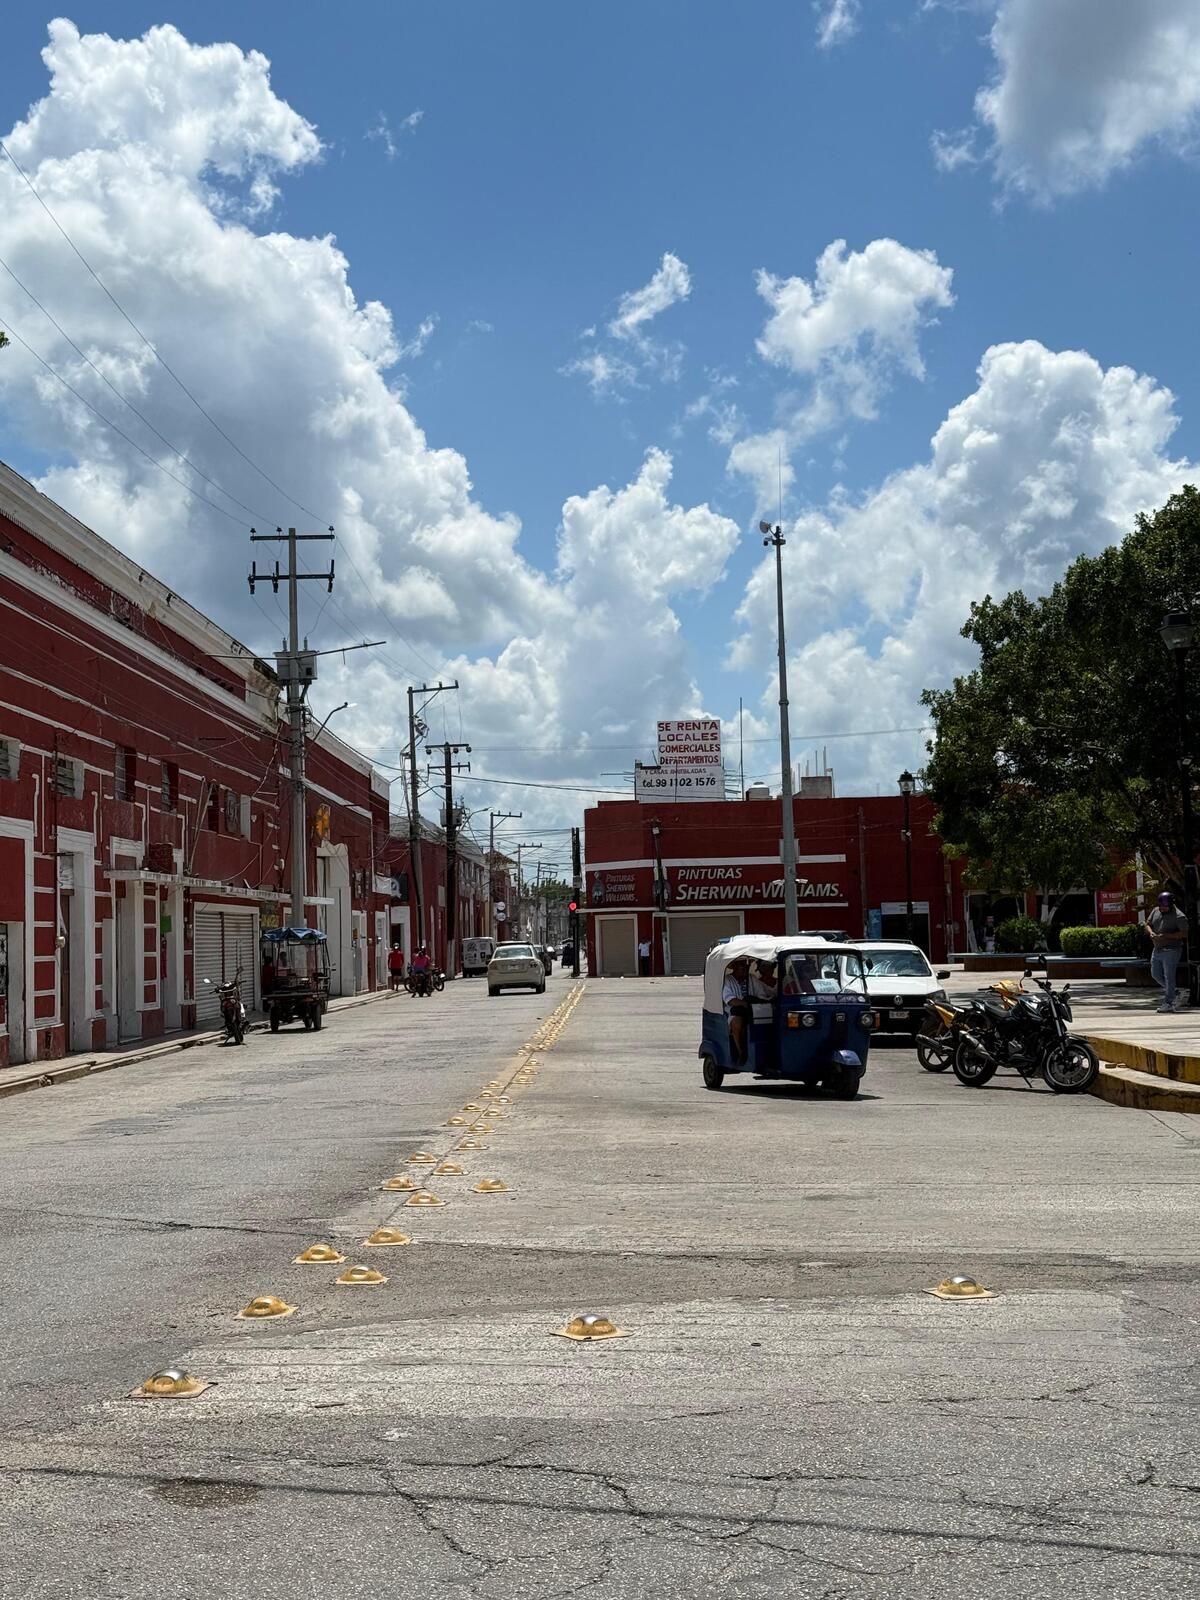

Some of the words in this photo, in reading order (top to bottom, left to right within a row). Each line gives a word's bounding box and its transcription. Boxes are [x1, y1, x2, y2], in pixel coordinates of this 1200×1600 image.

[658, 722, 671, 732] SE
[677, 721, 718, 731] RENTA
[658, 733, 718, 742] LOCALES
[659, 744, 721, 753] COMERCIALES
[660, 755, 719, 765] DEPARTAMENTOS
[606, 874, 635, 882] PINTURAS
[678, 868, 743, 881] PINTURAS
[606, 884, 635, 892] SHERWIN
[676, 882, 844, 901] SHERWIN-WIIAMS.
